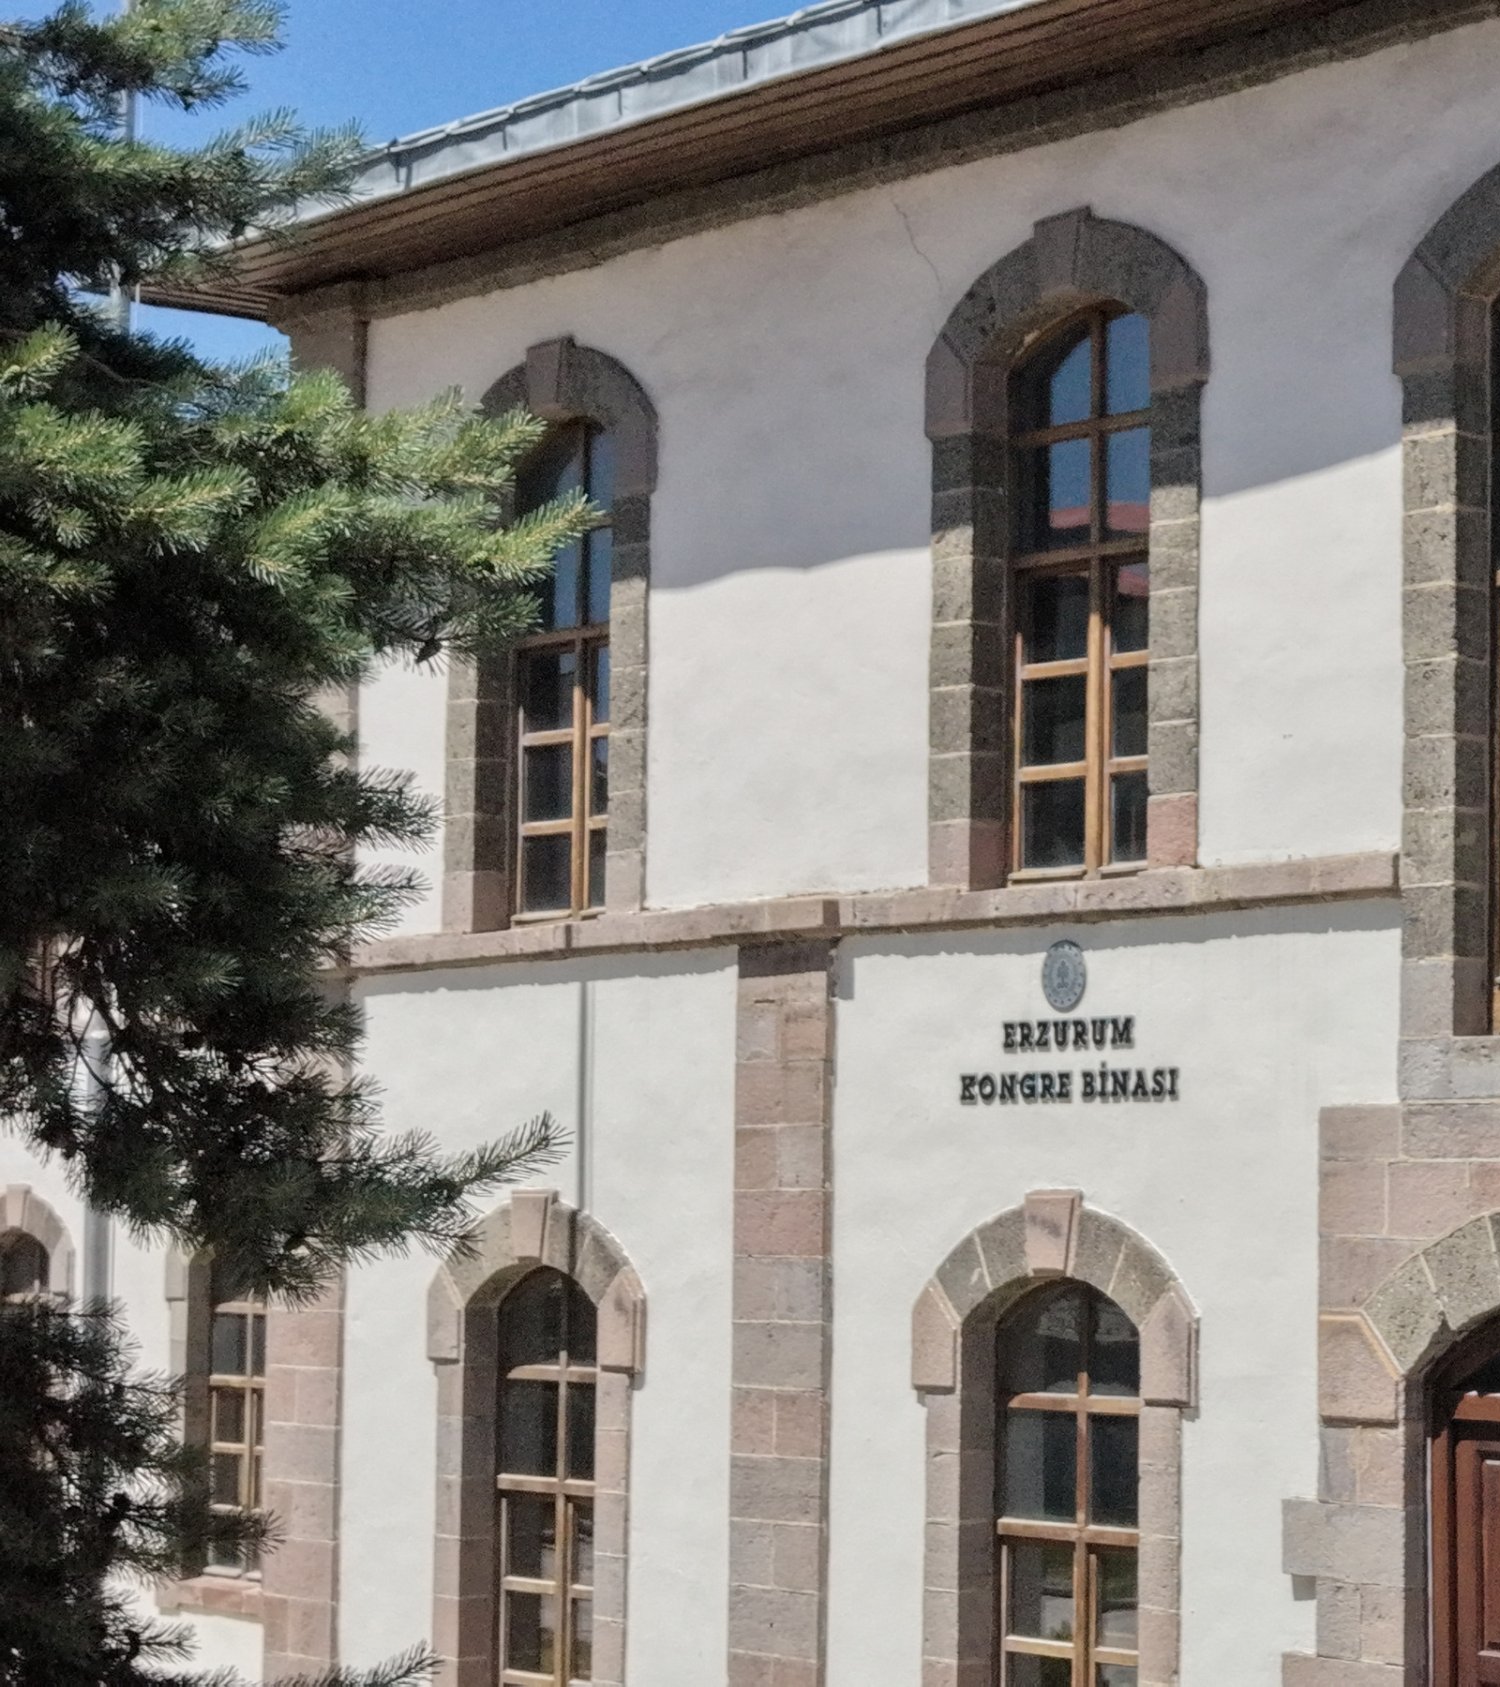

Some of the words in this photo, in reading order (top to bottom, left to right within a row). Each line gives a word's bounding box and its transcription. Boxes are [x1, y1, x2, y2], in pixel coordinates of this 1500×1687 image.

[1002, 1017, 1134, 1050] ERZURUM
[960, 1072, 1072, 1102] KONGRE
[1081, 1061, 1178, 1099] BİNASI
